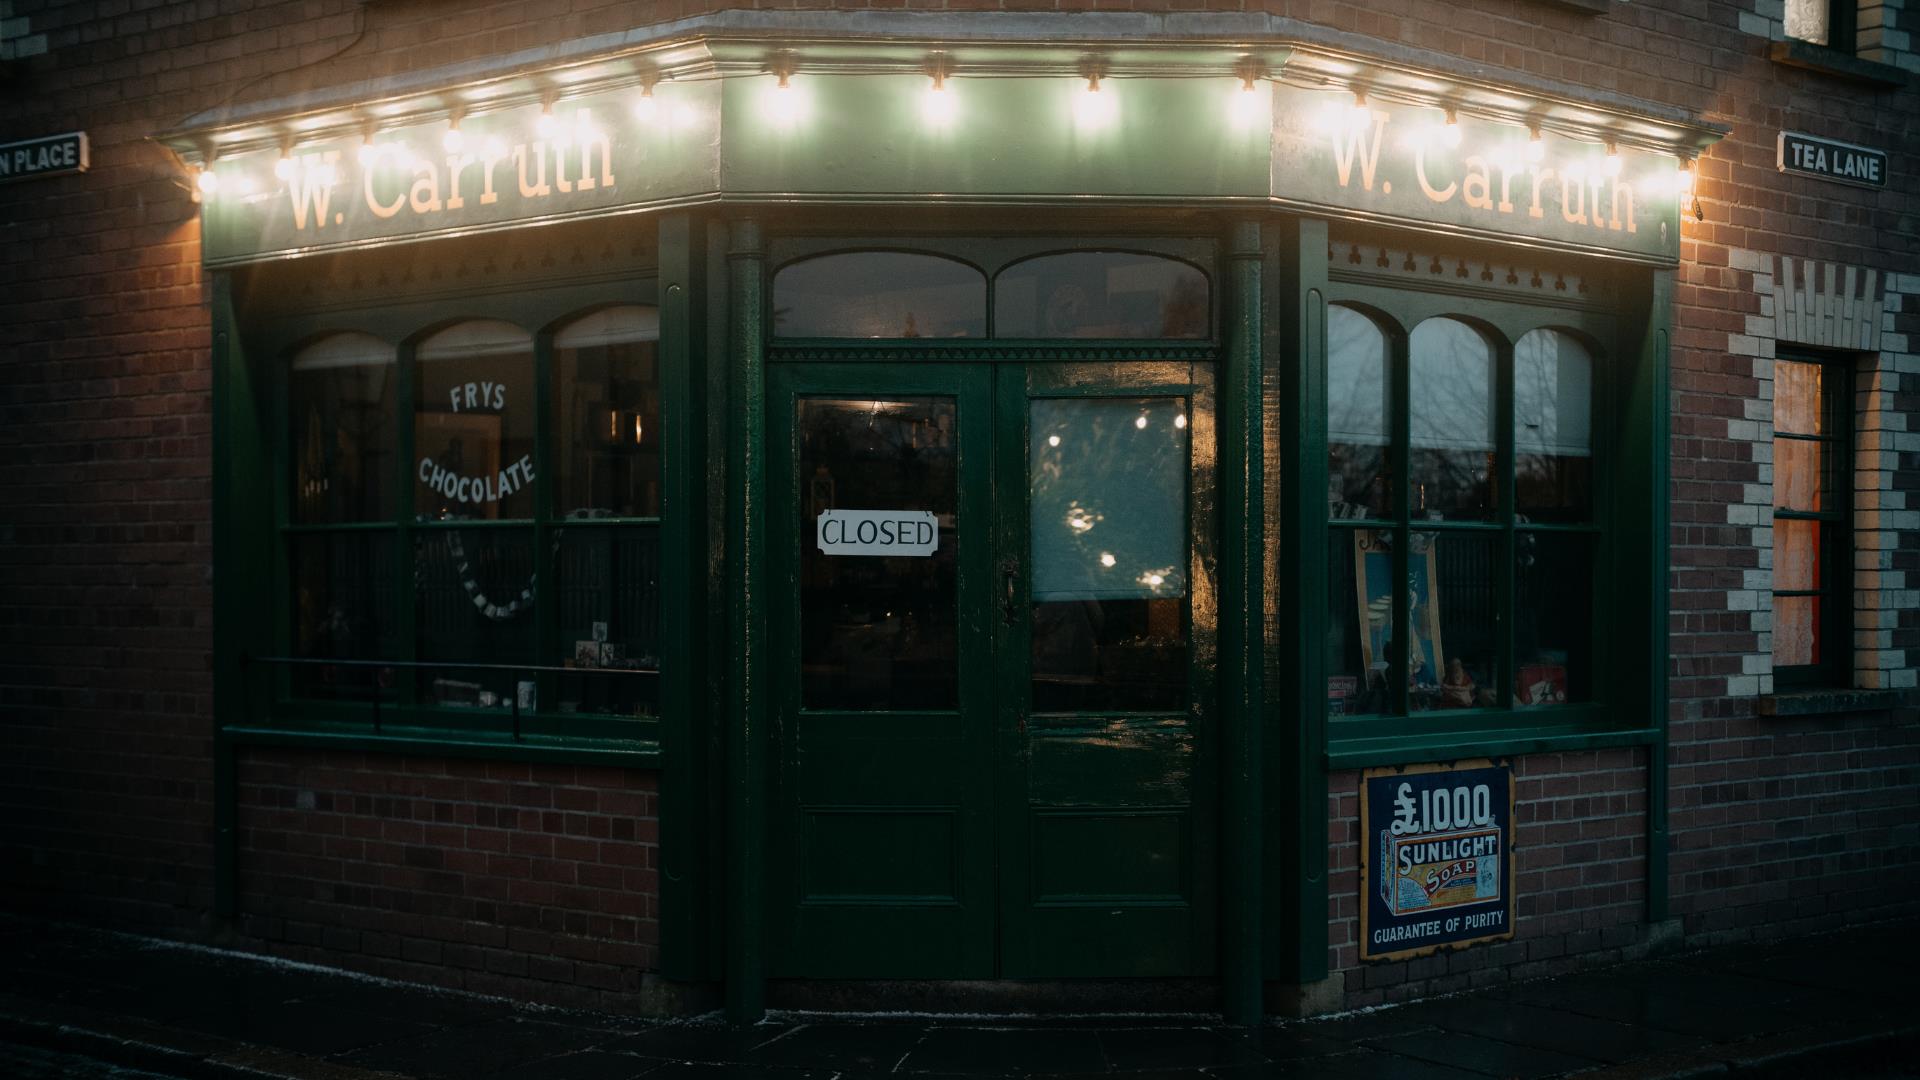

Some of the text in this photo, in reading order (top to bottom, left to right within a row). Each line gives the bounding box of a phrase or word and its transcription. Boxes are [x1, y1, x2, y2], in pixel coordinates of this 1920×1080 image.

[14, 142, 76, 173] PLACE
[363, 108, 615, 218] Carruth
[1792, 142, 1880, 181] TEA LANE
[1414, 127, 1637, 233] Carruth
[449, 381, 506, 413] FRYS
[418, 454, 537, 503] CHOCOLATE
[821, 519, 935, 546] CLOSED
[1390, 782, 1491, 835] £1000
[1398, 835, 1498, 876] SUNLIGHT
[1425, 860, 1475, 893] SOAP
[1374, 910, 1504, 945] GUARANTEE OF PURITY
